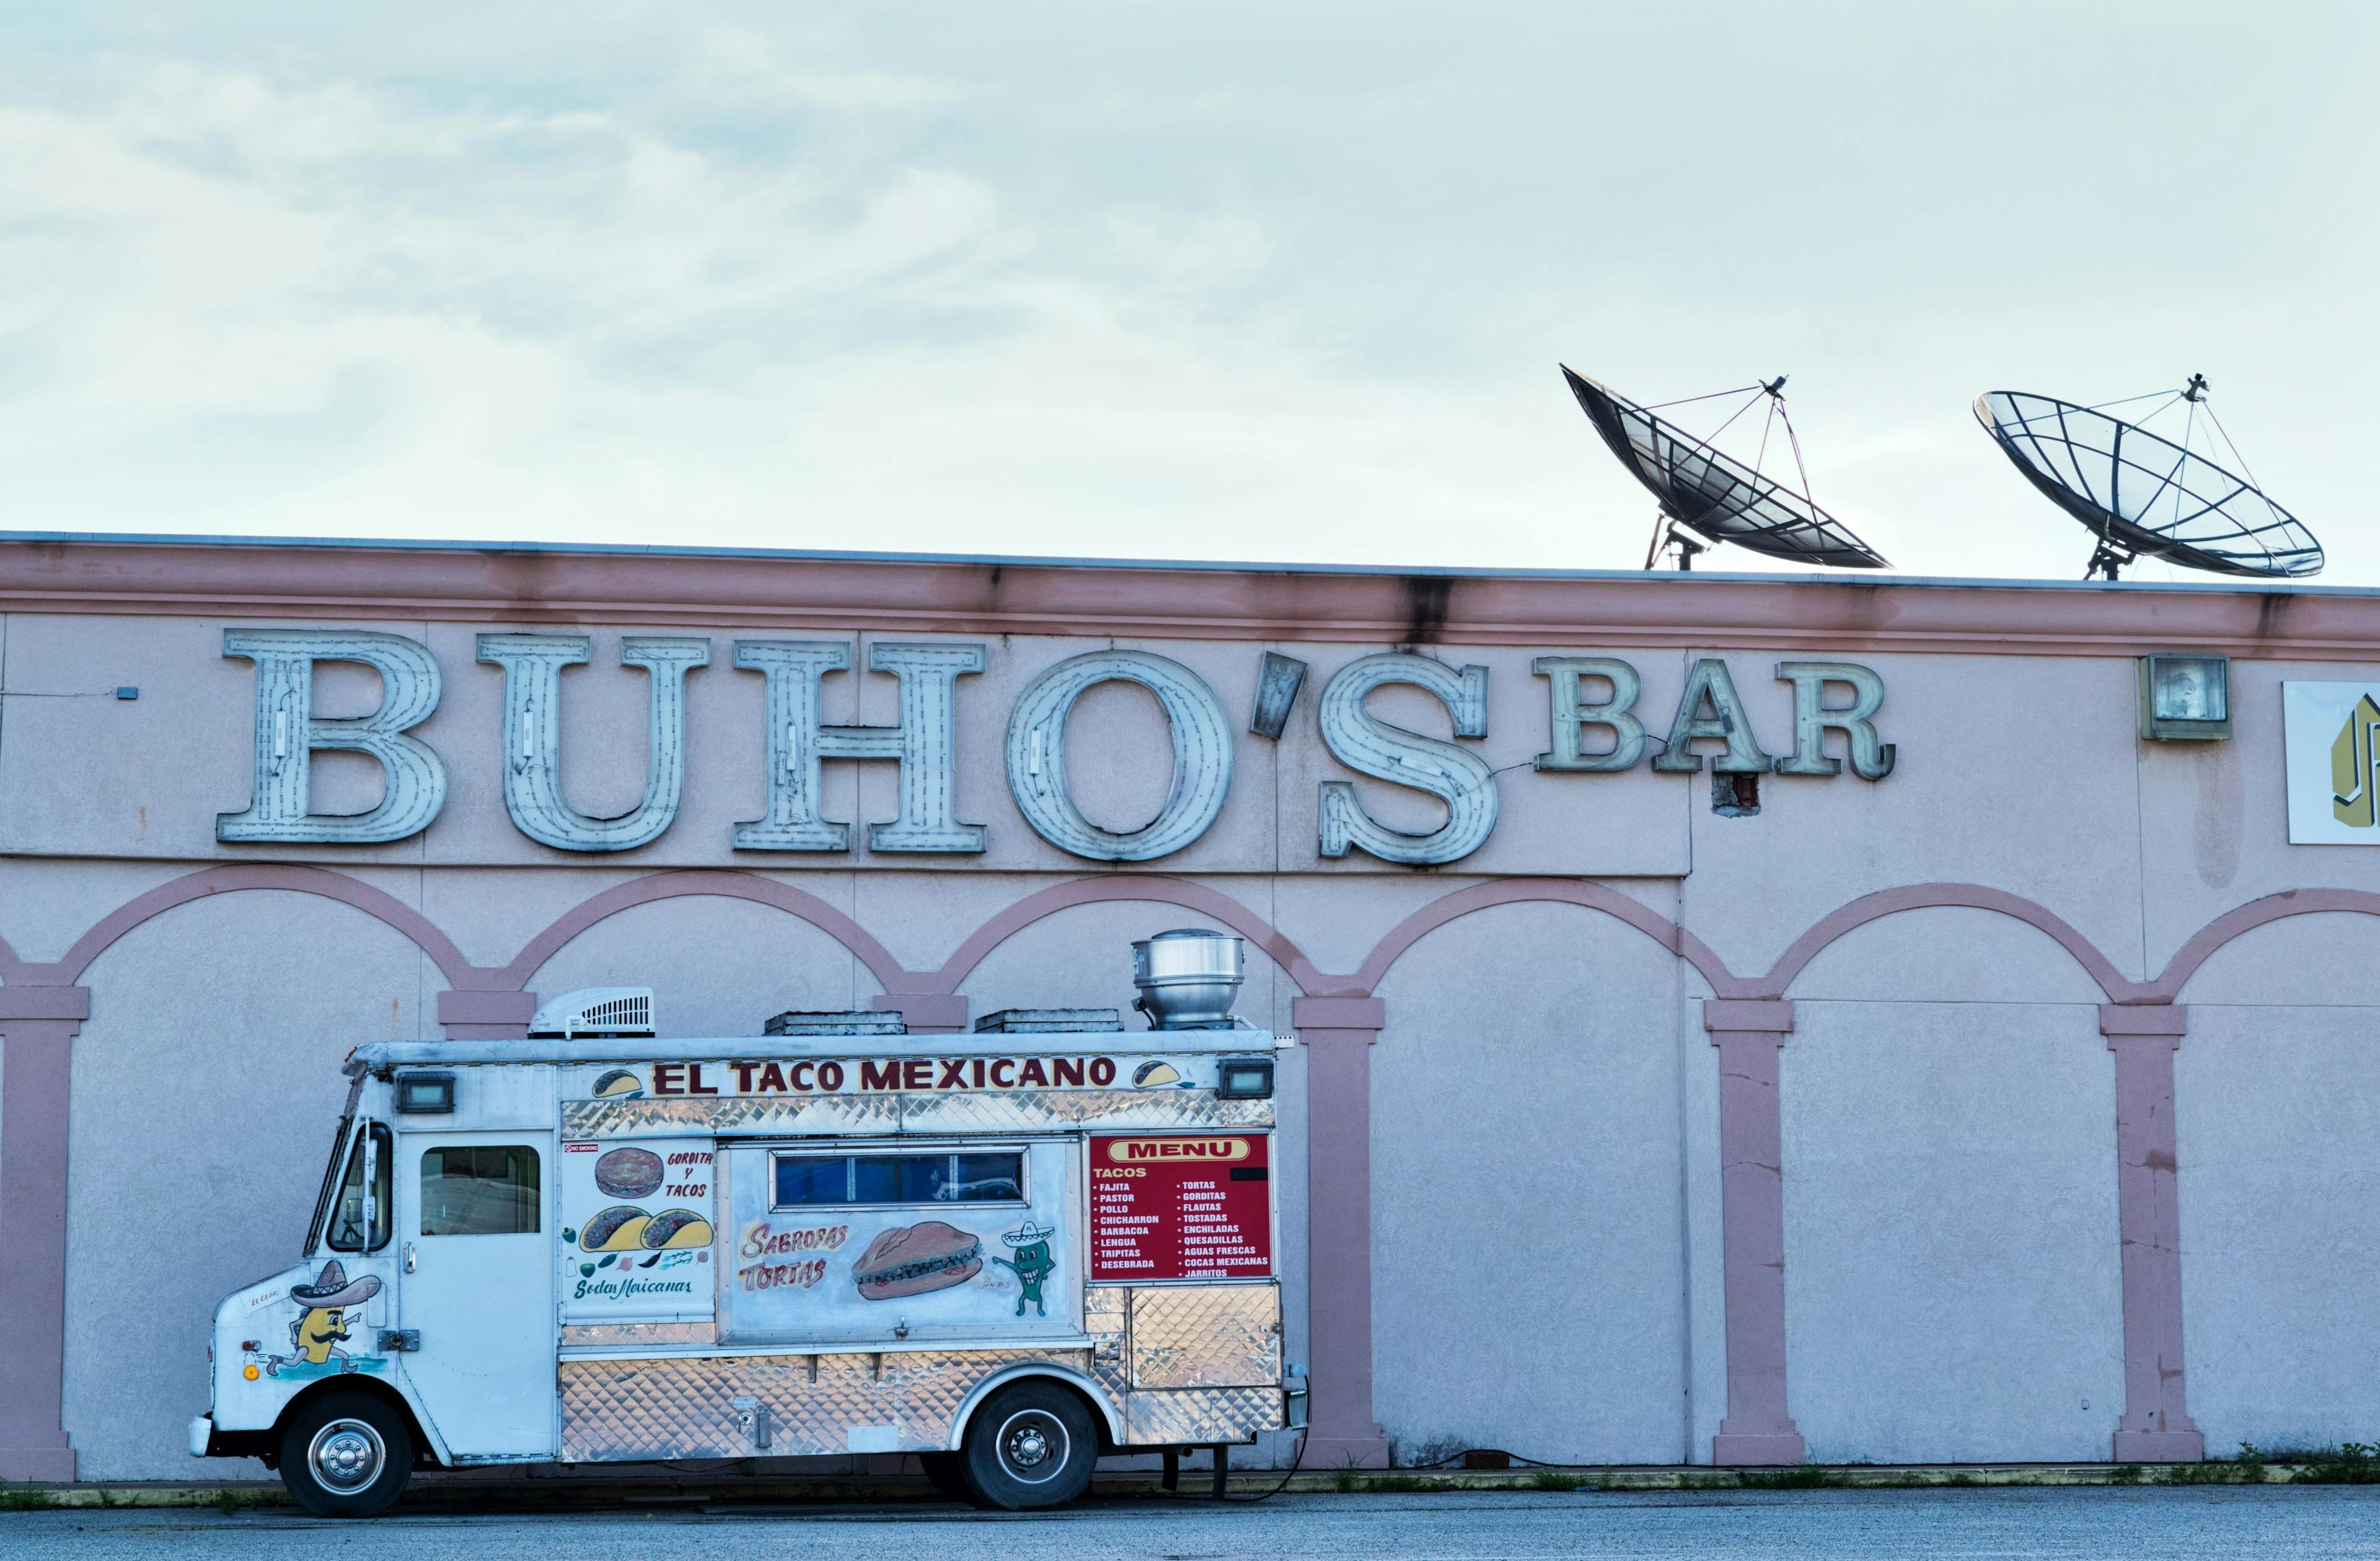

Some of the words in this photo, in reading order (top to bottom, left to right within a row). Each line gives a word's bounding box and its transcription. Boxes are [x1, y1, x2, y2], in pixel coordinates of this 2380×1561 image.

[215, 627, 1499, 866] BUHO'S
[1532, 656, 1897, 781] BAR
[650, 1063, 719, 1096] EL
[728, 1062, 845, 1094] TACO
[859, 1057, 1116, 1091] MEXICANO
[1127, 1141, 1232, 1159] MENU
[684, 1167, 693, 1179] Y
[1093, 1167, 1147, 1178] TACOS
[1100, 1183, 1130, 1191] FAJITA
[1183, 1181, 1215, 1189] TORTAS
[666, 1184, 707, 1197] TACOS
[1100, 1194, 1134, 1202] PASTOR
[1183, 1192, 1226, 1200] GORDITAS
[1100, 1205, 1128, 1213] POLLO
[1183, 1203, 1222, 1211] FLAUTAS
[1100, 1215, 1159, 1225] CHICHARRON
[1183, 1214, 1228, 1223] TOSTADAS
[1101, 1227, 1149, 1236] BARBACOA
[1184, 1225, 1240, 1234] ENCHILADAS
[1101, 1238, 1137, 1247] LENGUA
[1184, 1236, 1243, 1245] QUESADILLAS
[1101, 1249, 1140, 1258] TRIPITAS
[1184, 1247, 1214, 1255] AGUAS
[1216, 1246, 1256, 1255] FRESCAS
[1101, 1260, 1154, 1269] DESEBRADA
[1184, 1258, 1214, 1267] COCAS
[1216, 1257, 1268, 1265] MEXICANAS
[738, 1259, 827, 1291] TORTAS
[1185, 1269, 1227, 1278] JARRITOS
